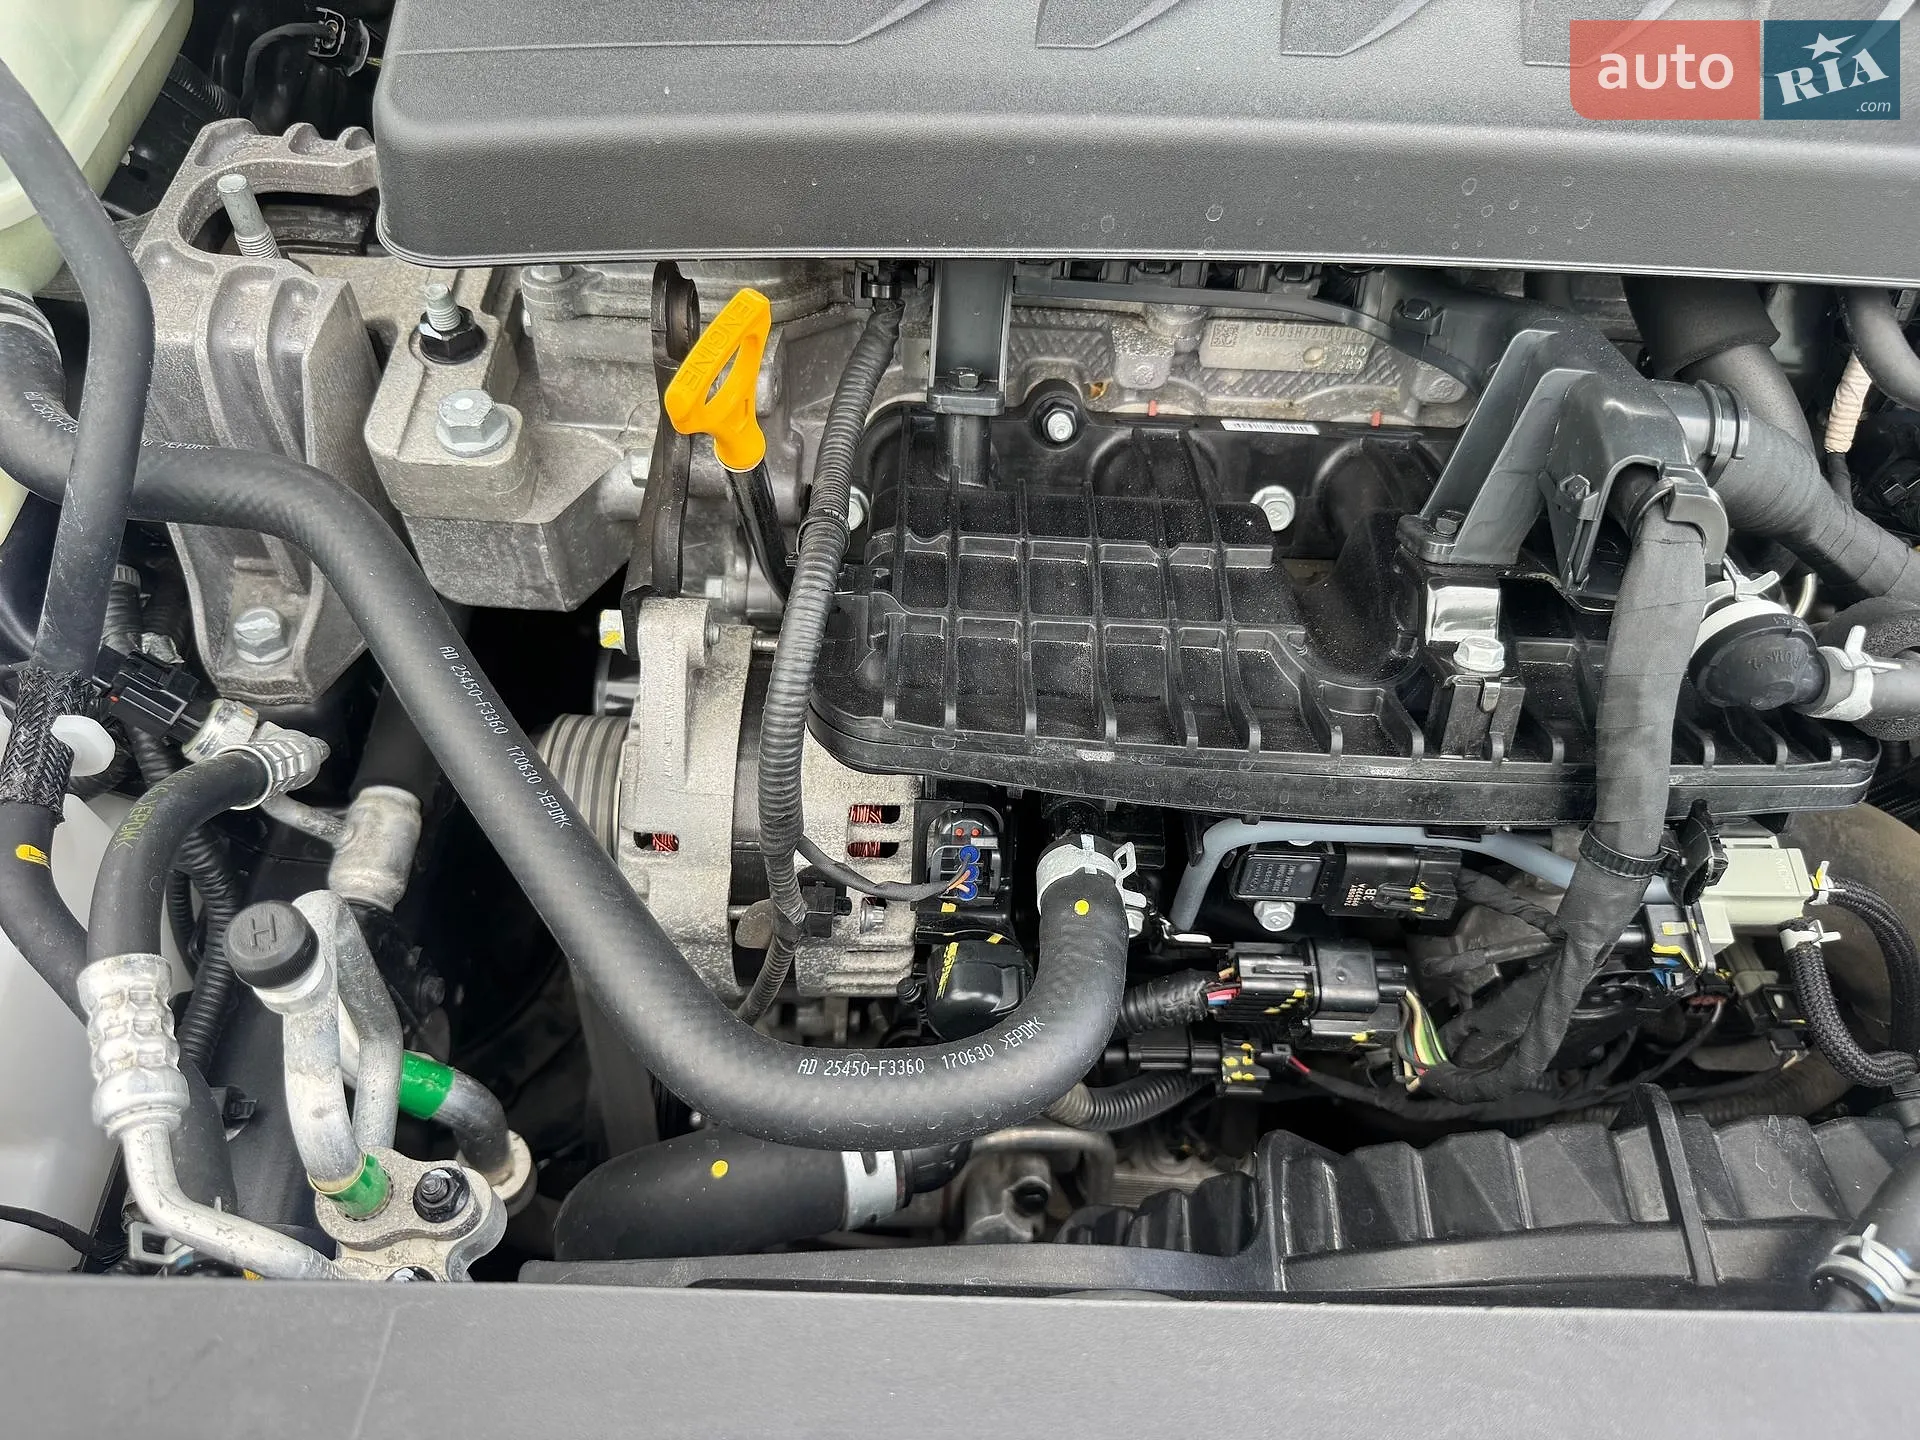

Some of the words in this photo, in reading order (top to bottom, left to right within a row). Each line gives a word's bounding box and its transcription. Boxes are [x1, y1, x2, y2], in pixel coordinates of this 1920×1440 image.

[680, 300, 754, 391] ENGINE
[439, 646, 460, 661] AD
[451, 664, 509, 735] 25450-F3360
[506, 745, 542, 784] 170630
[251, 913, 277, 947] H
[797, 1059, 818, 1075] AD
[823, 1060, 925, 1077] 25450-F3360
[941, 1044, 995, 1070] 170630
